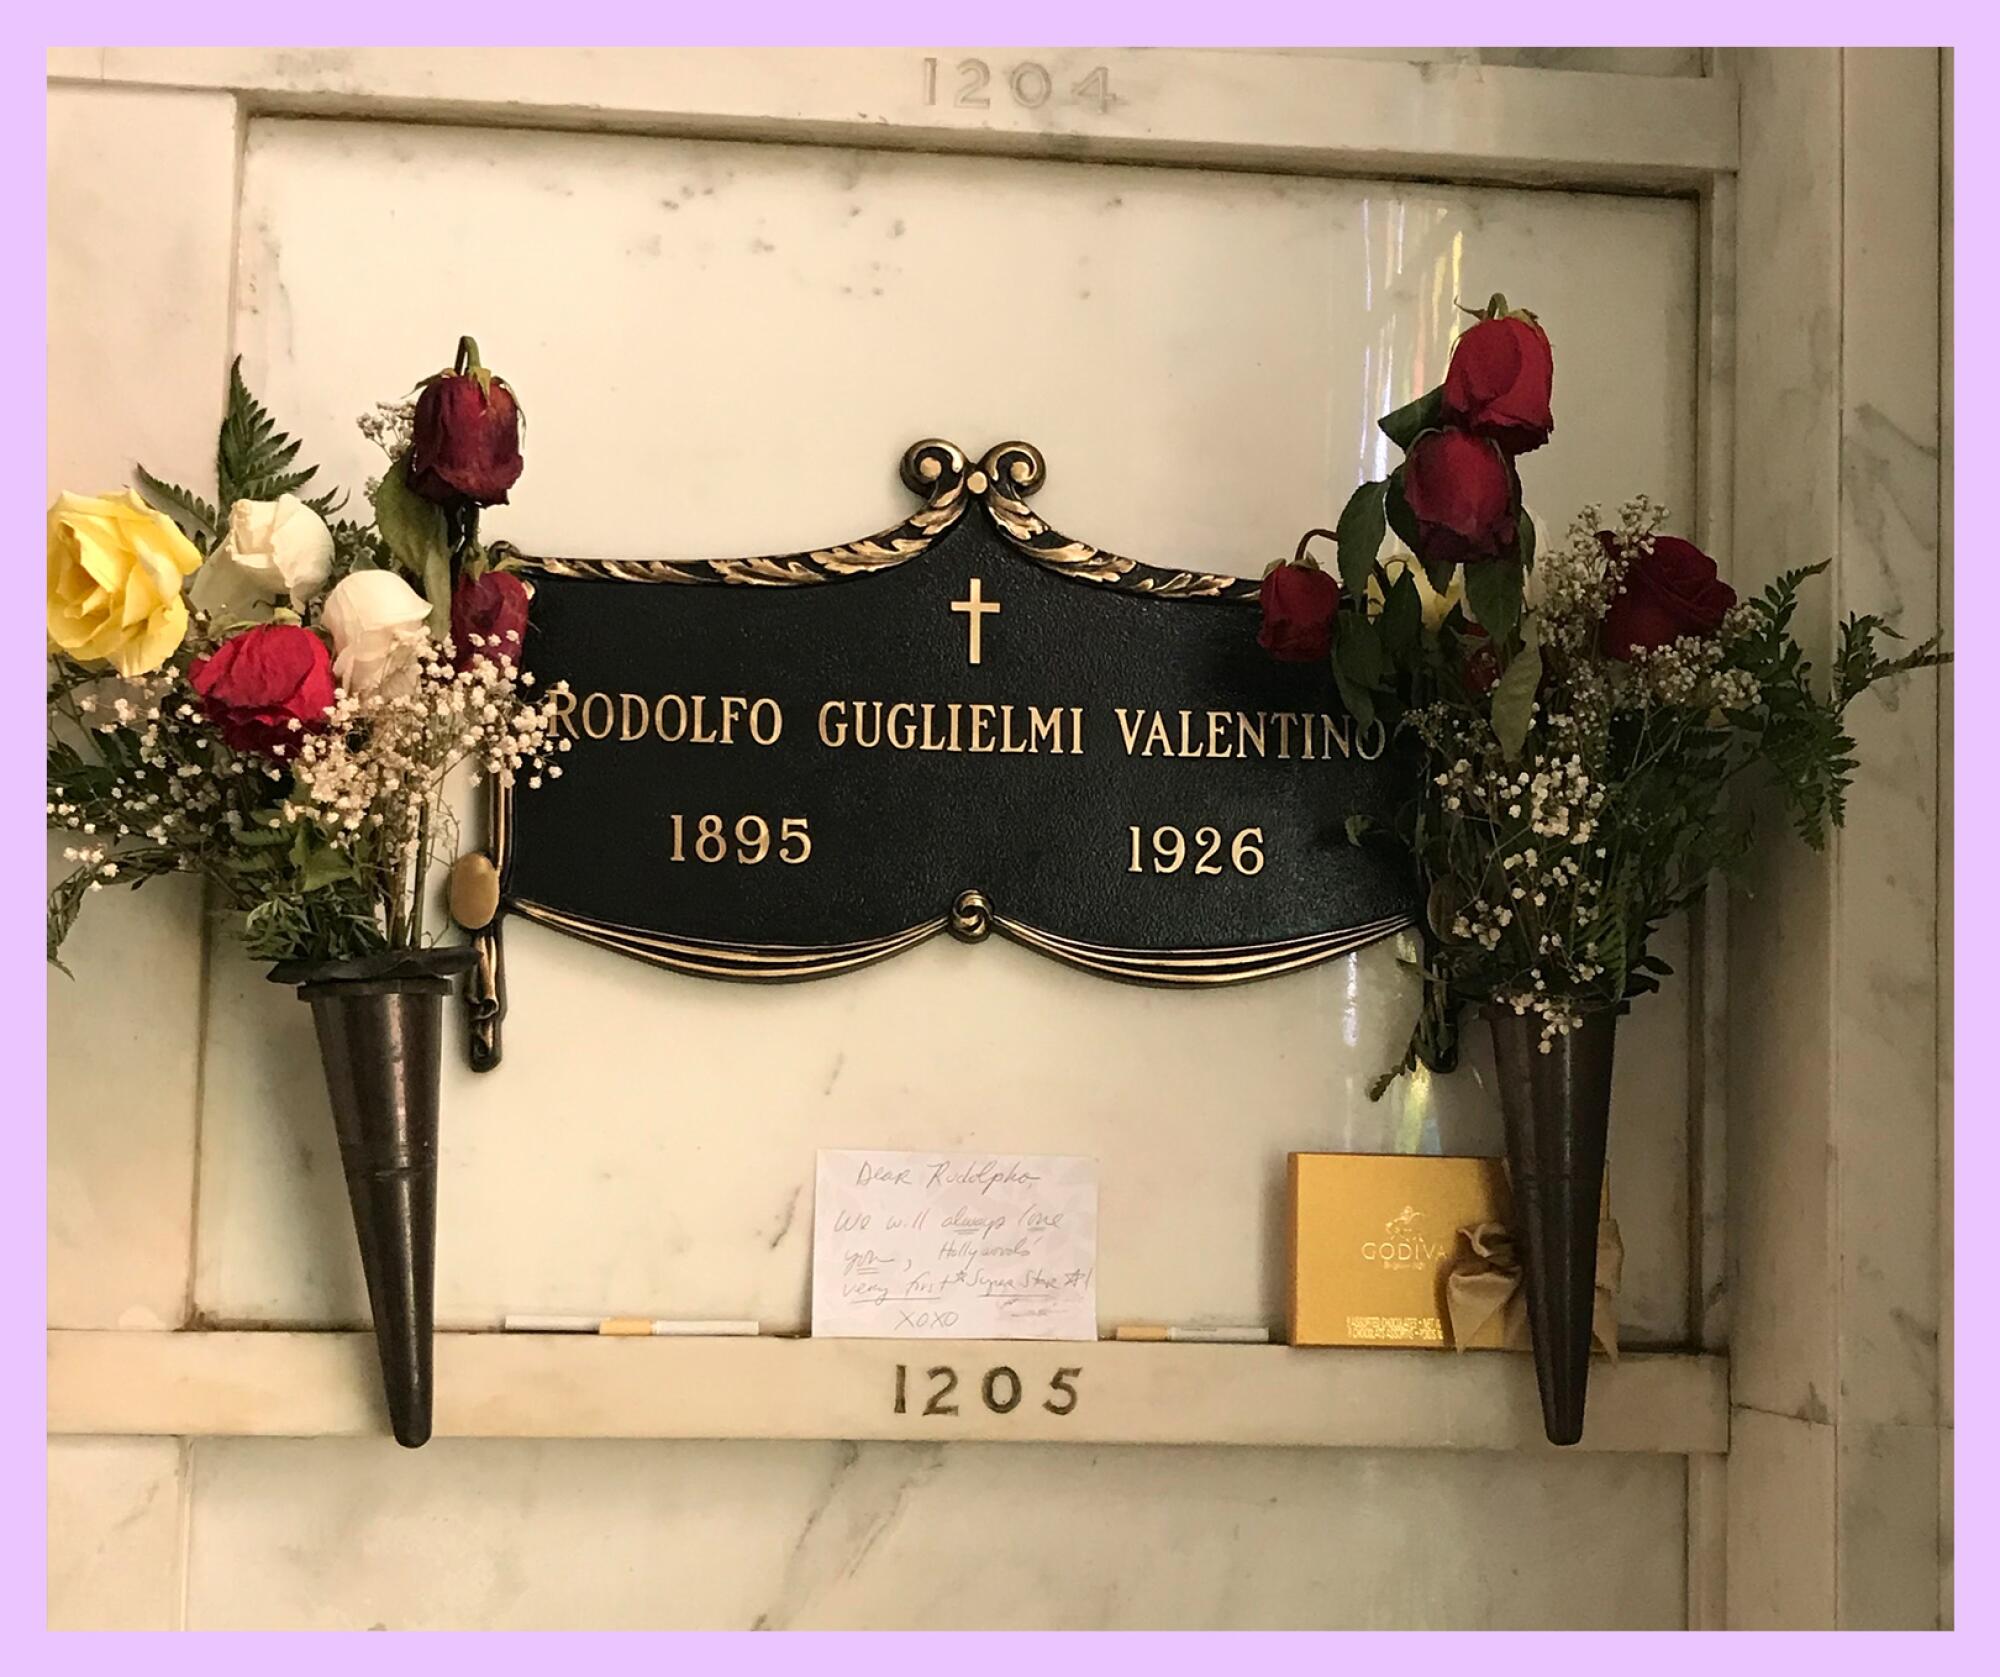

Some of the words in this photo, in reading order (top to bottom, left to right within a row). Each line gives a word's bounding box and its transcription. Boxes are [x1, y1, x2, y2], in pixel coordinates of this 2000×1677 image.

[923, 56, 1128, 116] 1204
[545, 689, 784, 746] RODOLFO
[817, 700, 1085, 755] GUGLIELMI
[1113, 707, 1386, 760] VALENTINO
[669, 813, 813, 865] 1895
[1127, 824, 1265, 876] 1926
[833, 1208, 872, 1232] We
[886, 1207, 931, 1231] will
[940, 1205, 1006, 1240] always
[1017, 1203, 1064, 1230] love
[1361, 1242, 1448, 1261] GODIVA
[842, 1281, 889, 1306] very
[905, 1270, 953, 1297] first
[894, 1310, 959, 1331] XOXO
[893, 1363, 1083, 1417] 1205
